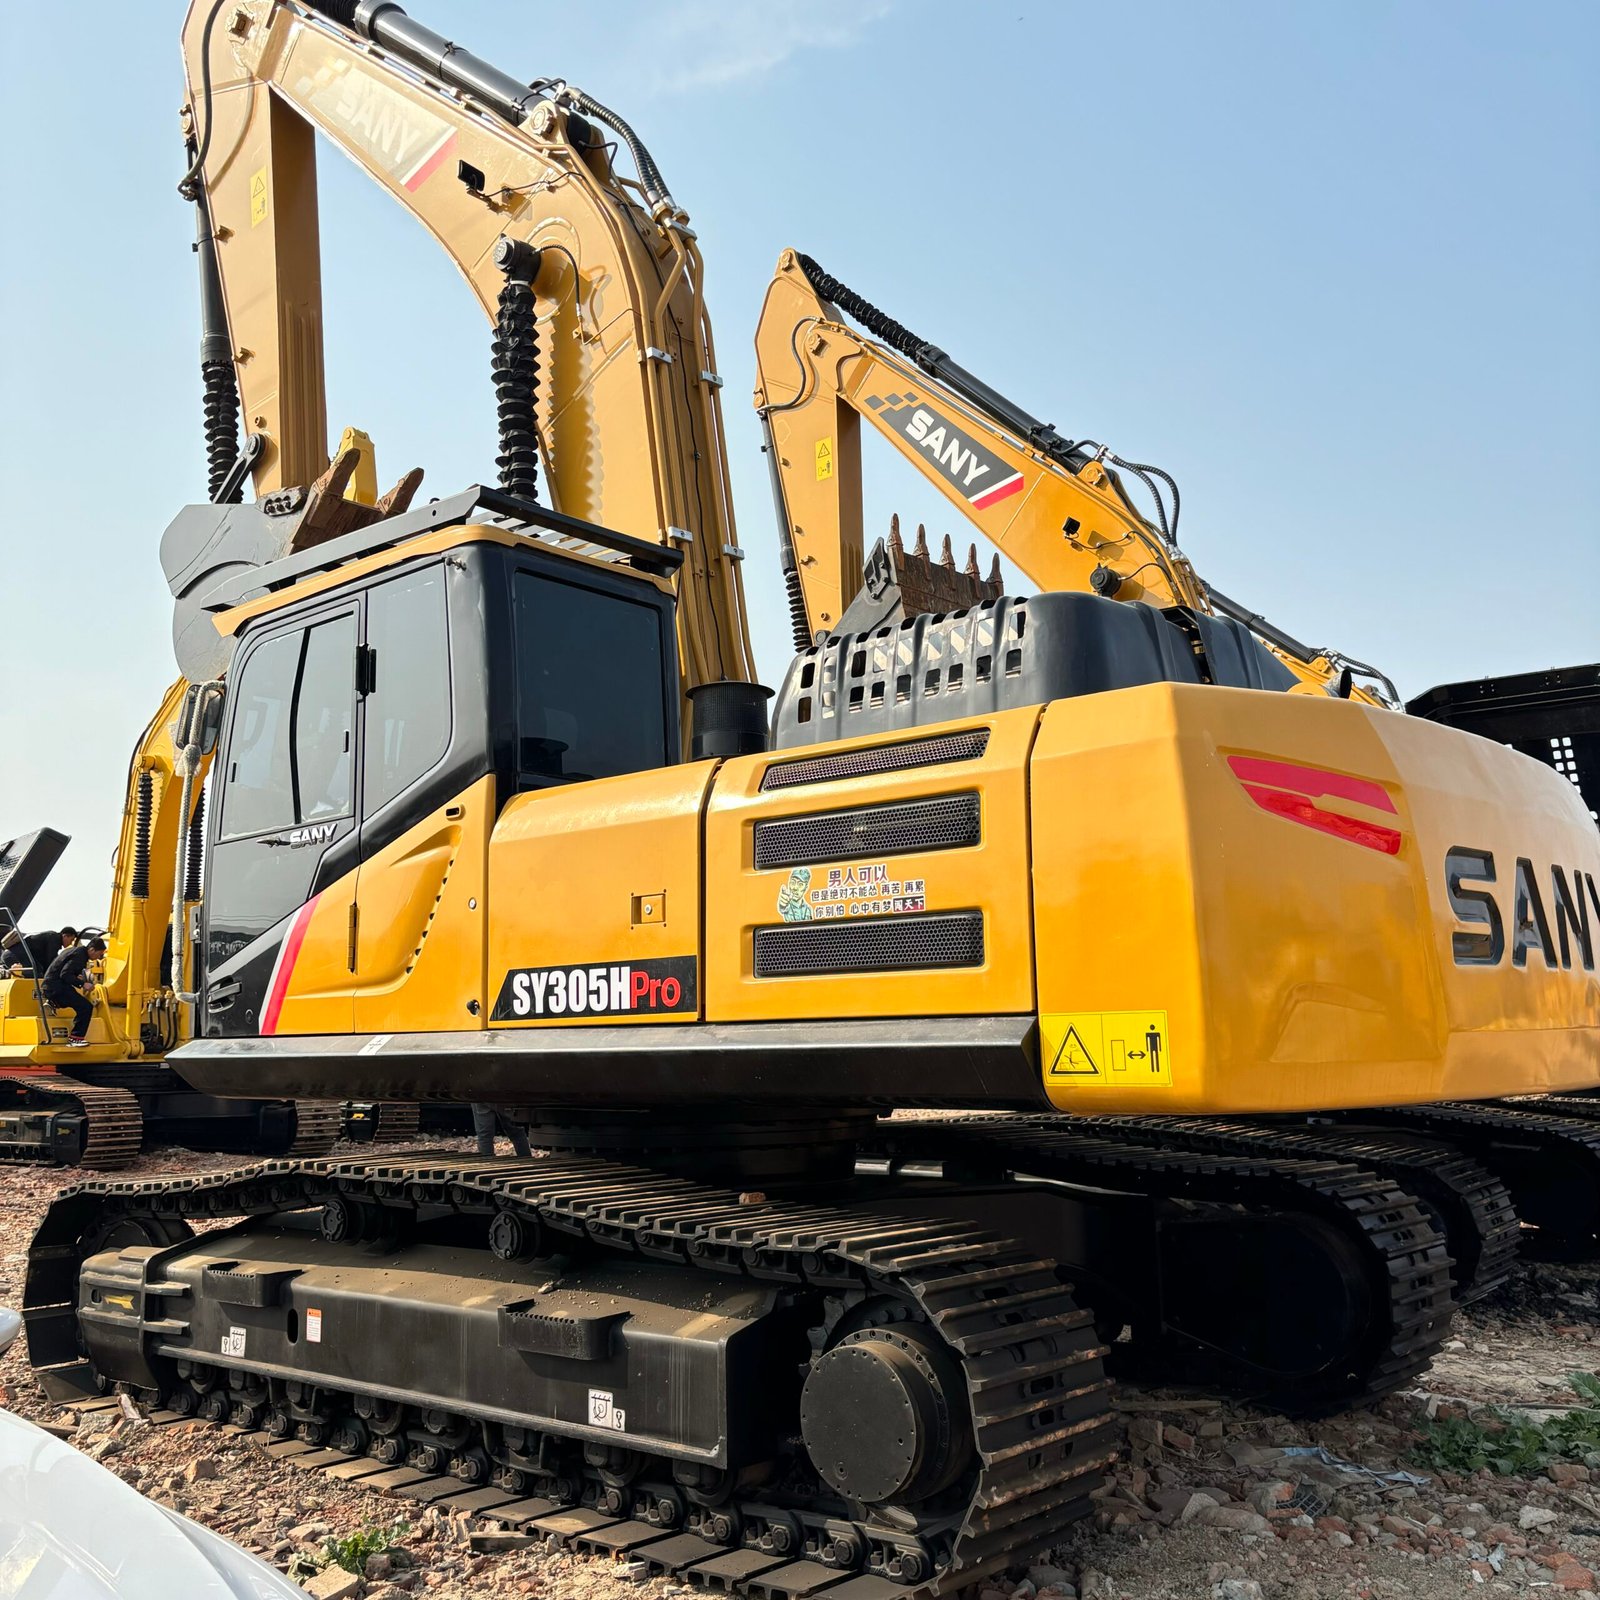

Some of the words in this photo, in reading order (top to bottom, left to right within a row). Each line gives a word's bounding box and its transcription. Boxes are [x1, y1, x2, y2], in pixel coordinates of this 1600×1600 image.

[336, 82, 420, 164] SANY
[905, 409, 990, 487] SANY
[290, 823, 338, 846] SANY
[829, 865, 888, 887] 男人可以
[811, 886, 877, 902] 但是绝对不能怂
[881, 882, 900, 895] 再苦
[905, 881, 924, 893] 再累
[815, 905, 845, 918] 你别怕
